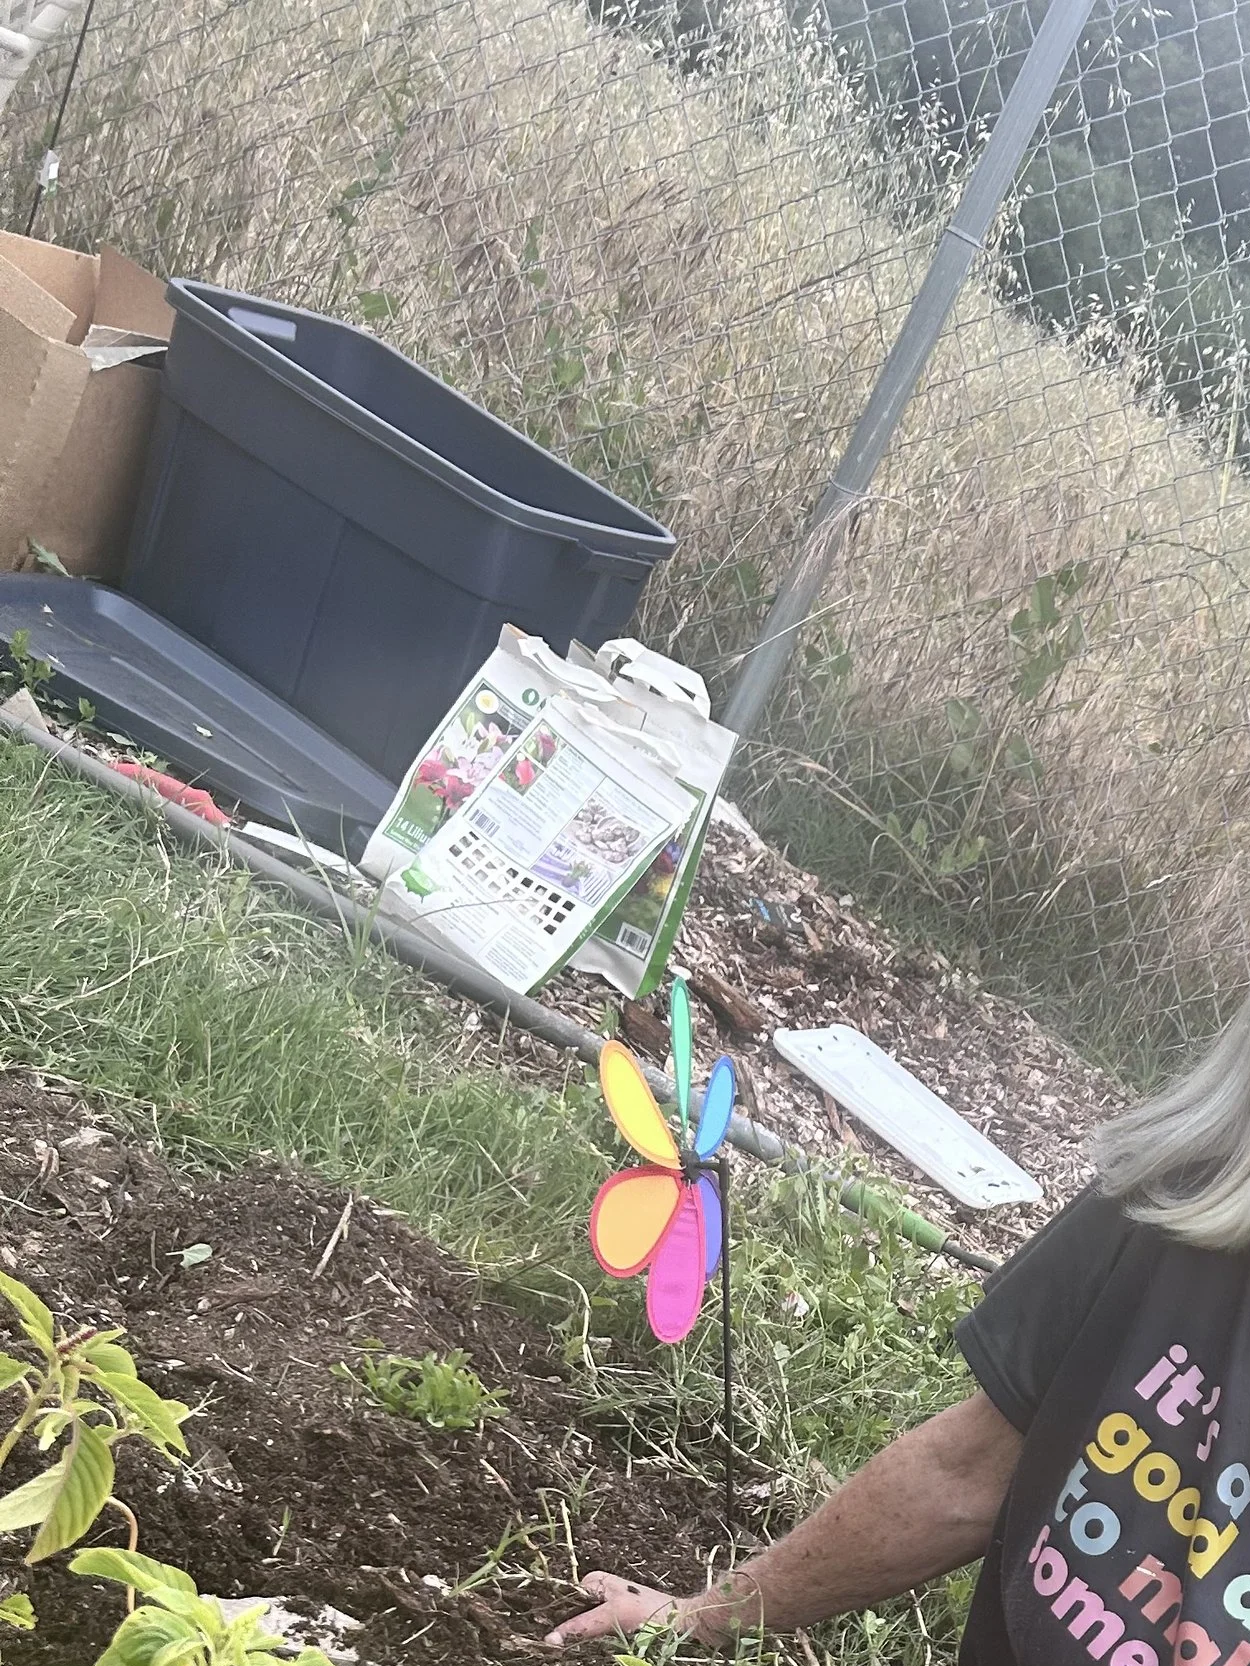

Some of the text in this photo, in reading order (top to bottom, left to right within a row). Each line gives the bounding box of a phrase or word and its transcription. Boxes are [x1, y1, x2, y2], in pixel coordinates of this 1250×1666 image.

[1134, 1344, 1221, 1462] it's
[1054, 1457, 1121, 1556] to
[1085, 1412, 1240, 1579] good
